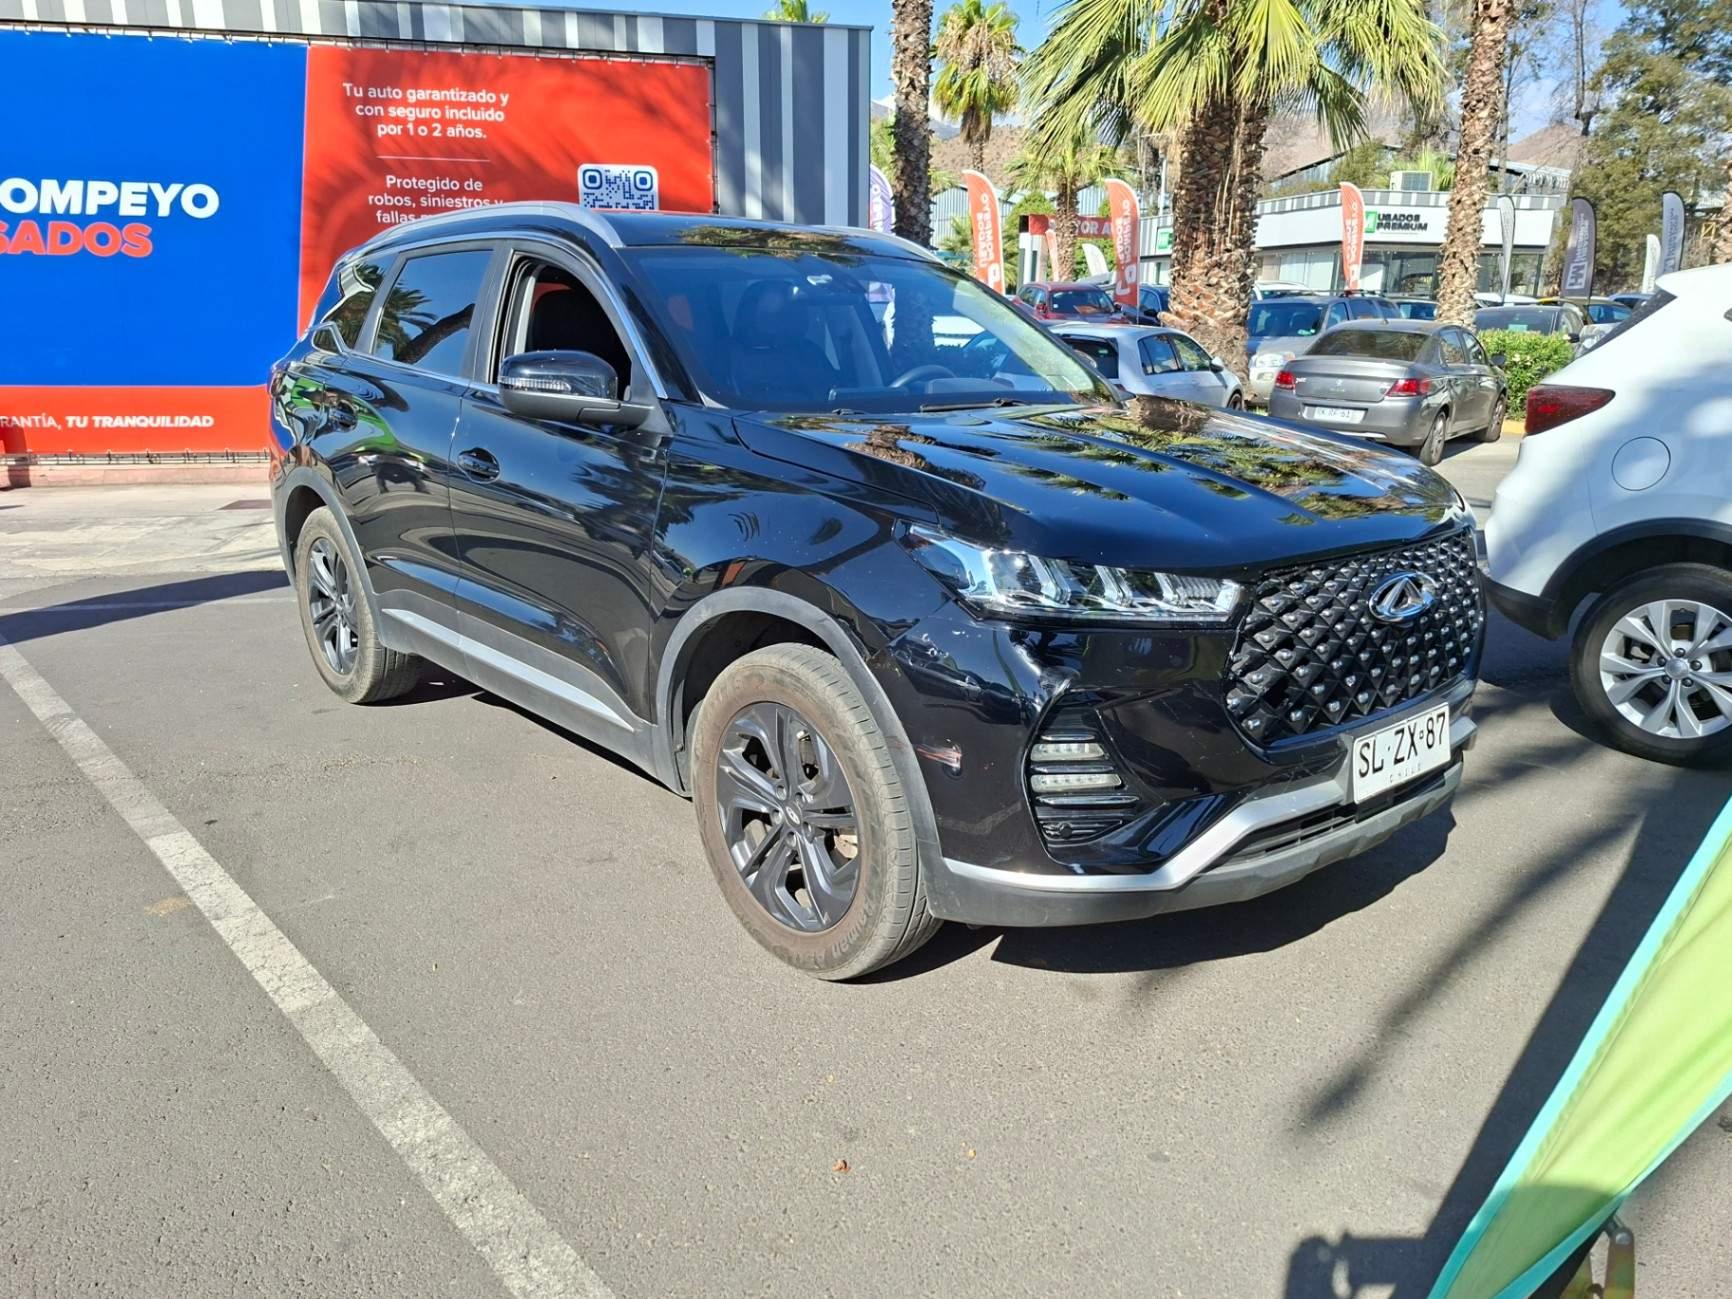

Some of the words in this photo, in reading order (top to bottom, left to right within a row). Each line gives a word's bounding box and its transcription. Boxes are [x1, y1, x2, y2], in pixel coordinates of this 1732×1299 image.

[343, 83, 363, 97] Tu
[368, 86, 402, 99] auto
[406, 88, 496, 103] garantizado
[500, 93, 509, 107] y
[355, 105, 384, 116] con
[388, 107, 441, 120] seguro
[445, 106, 505, 122] incluido
[377, 124, 403, 138] por
[407, 123, 414, 135] 1
[418, 126, 428, 136] o
[432, 123, 442, 137] 2
[447, 124, 487, 138] años.
[386, 175, 460, 192] Protegido
[464, 178, 483, 191] de
[0, 177, 219, 219] OMPEYO
[368, 193, 416, 208] robos,
[376, 210, 415, 223] fallas
[66, 415, 88, 428] TU
[92, 415, 214, 428] TRANQUILIDAD
